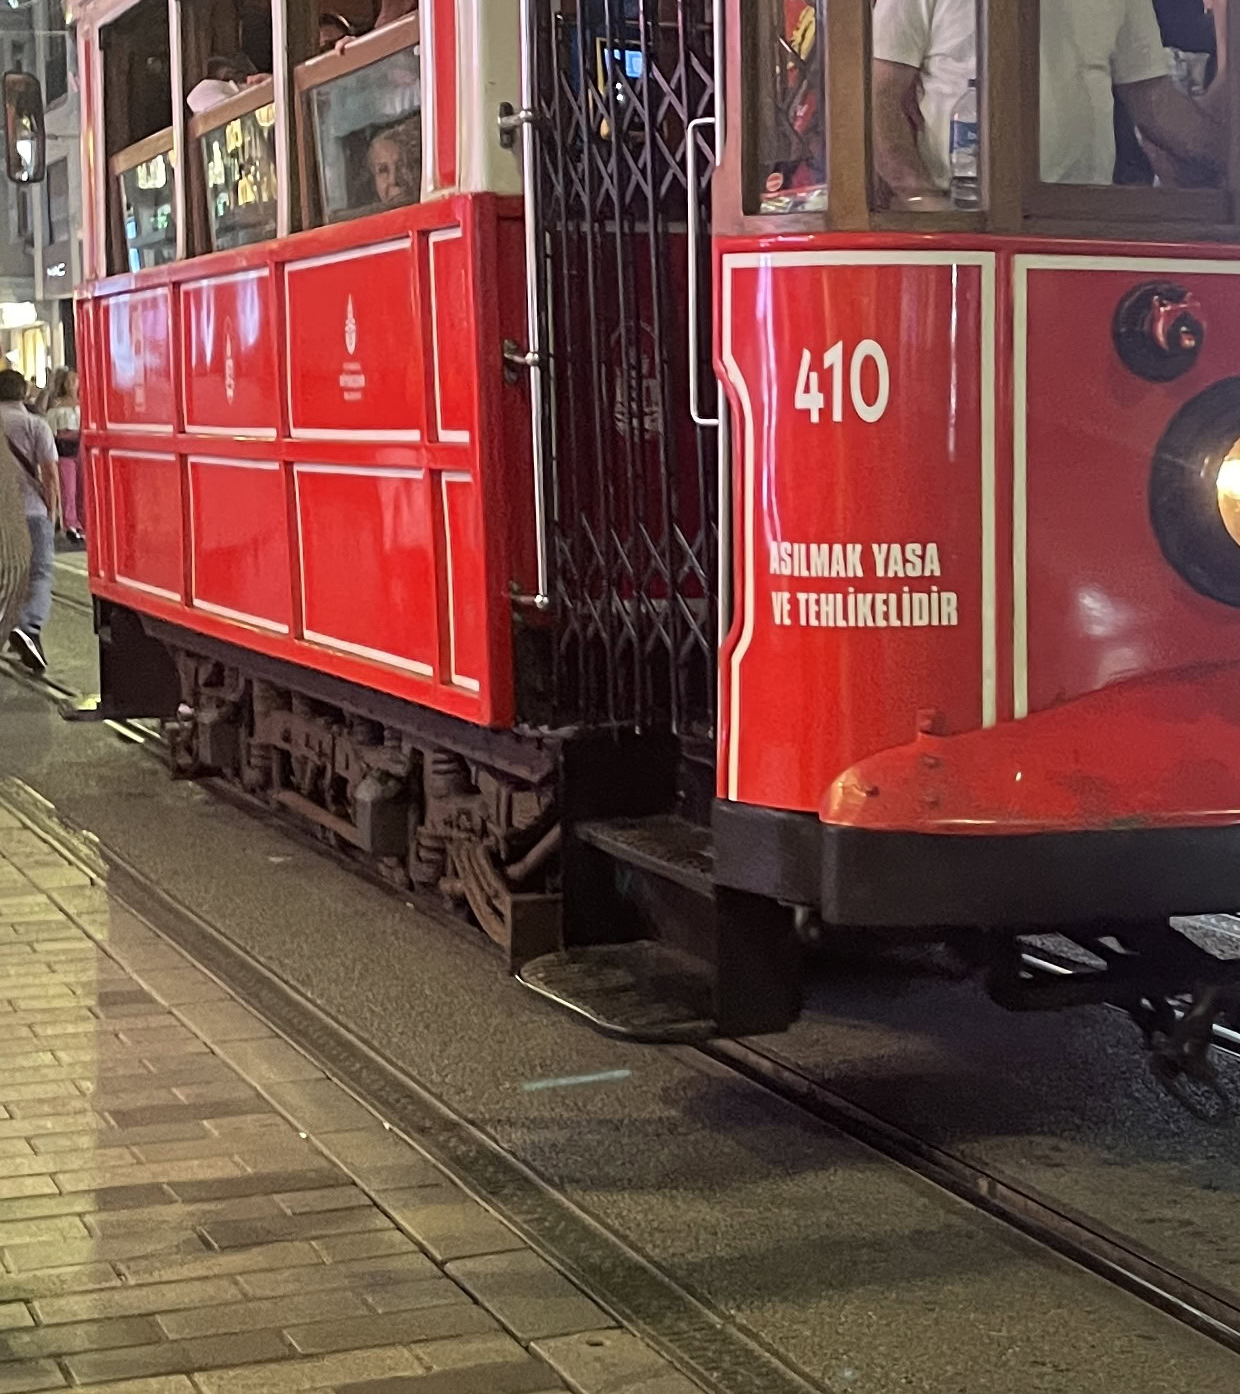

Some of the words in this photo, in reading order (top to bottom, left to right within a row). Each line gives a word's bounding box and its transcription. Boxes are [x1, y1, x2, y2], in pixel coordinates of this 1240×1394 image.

[795, 339, 890, 423] 410
[769, 542, 864, 579] ASILMAK
[872, 542, 941, 578] YASA
[771, 591, 791, 625] VE
[796, 586, 959, 627] TEHLİKELİDİR
